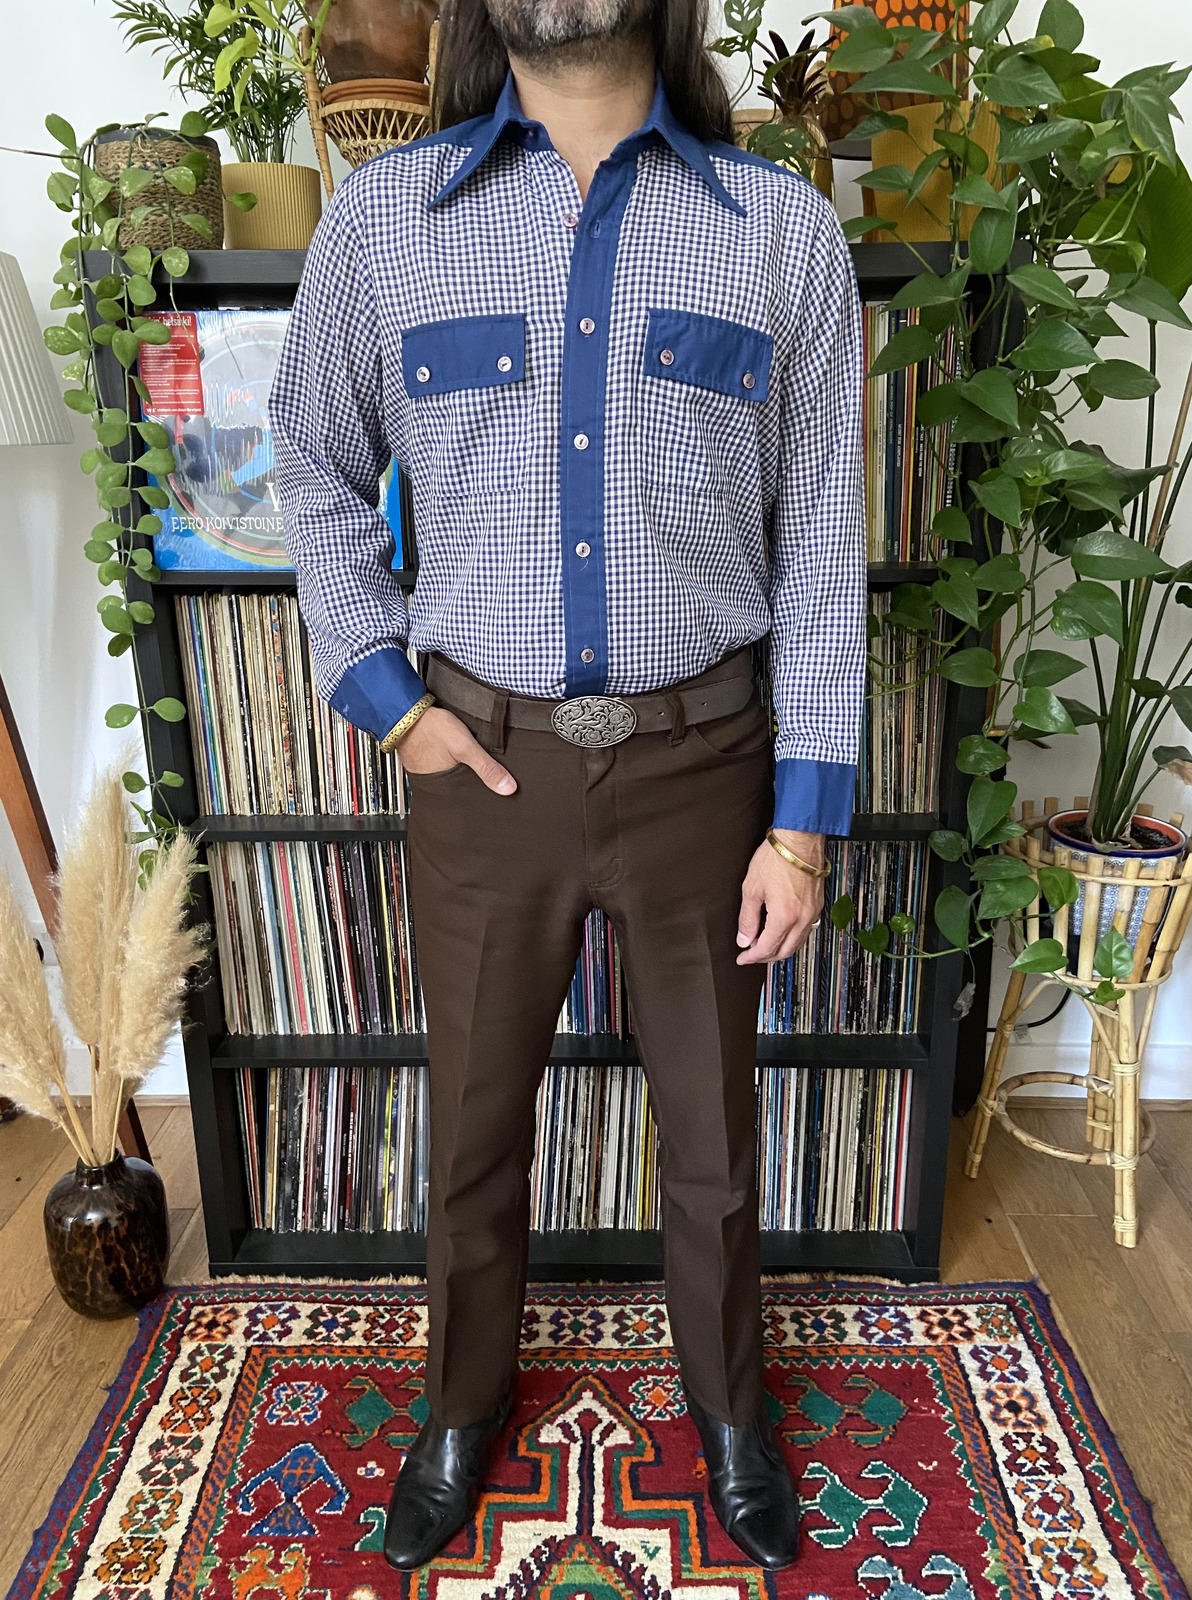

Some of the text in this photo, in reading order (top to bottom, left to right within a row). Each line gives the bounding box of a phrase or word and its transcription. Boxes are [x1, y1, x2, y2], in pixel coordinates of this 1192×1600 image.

[162, 315, 192, 327] helsiki!
[171, 516, 286, 533] EERO KOIVISTOINE
